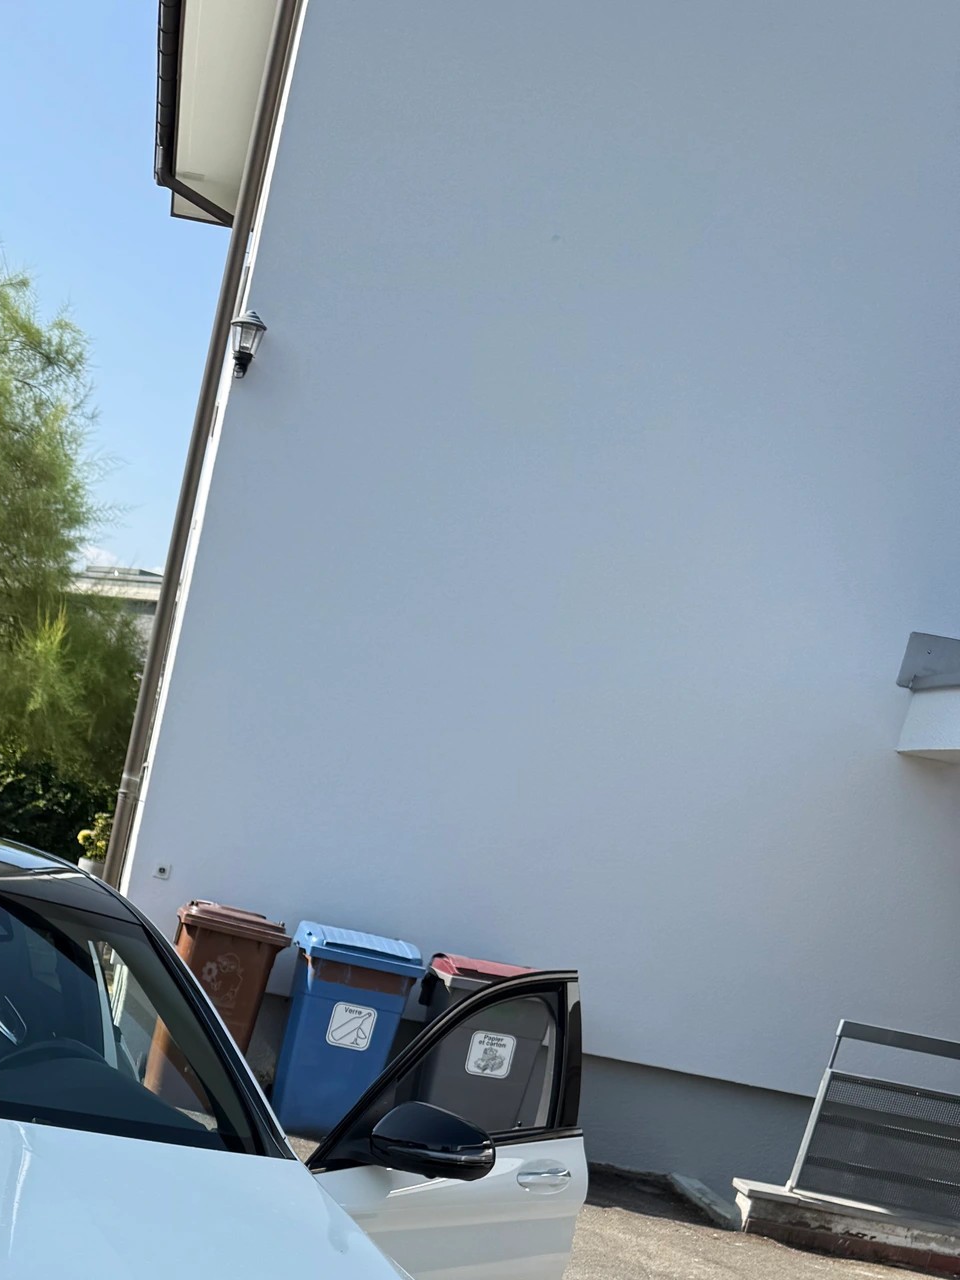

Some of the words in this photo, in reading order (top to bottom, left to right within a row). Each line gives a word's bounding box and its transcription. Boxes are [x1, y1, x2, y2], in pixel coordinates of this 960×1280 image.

[344, 1006, 362, 1016] Verre
[483, 1034, 504, 1042] Papier
[485, 1041, 507, 1049] carton
